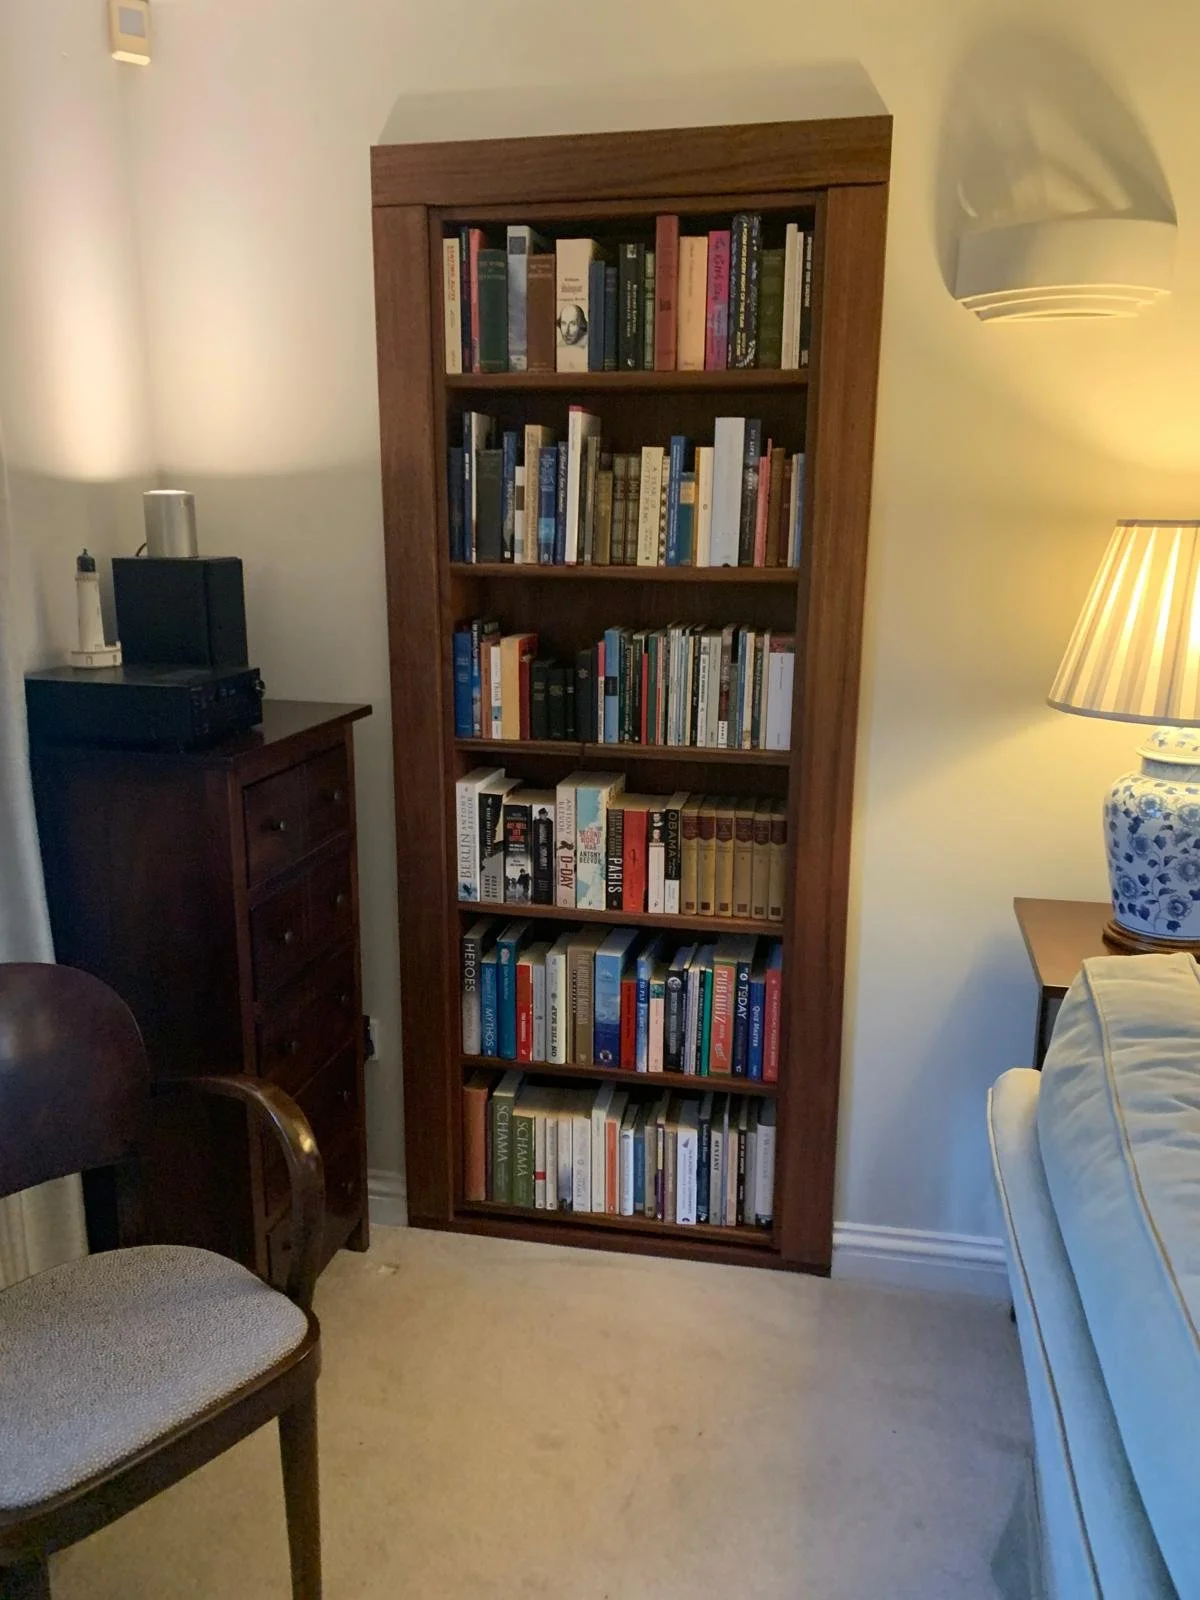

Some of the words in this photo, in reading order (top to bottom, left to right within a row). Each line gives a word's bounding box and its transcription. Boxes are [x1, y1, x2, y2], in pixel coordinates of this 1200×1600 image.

[668, 812, 678, 858] OBAMA
[460, 833, 472, 878] BERLIN
[560, 856, 573, 889] D-DAY
[608, 858, 623, 894] PARIS
[464, 943, 475, 992] HEROES
[713, 970, 728, 993] PUB
[713, 994, 728, 1024] QUIZ
[738, 984, 749, 1020] TODAY
[752, 1005, 760, 1022] QUIZ
[485, 1007, 494, 1047] MYTHOS
[752, 1022, 760, 1047] MASTER
[551, 1045, 558, 1057] ON
[496, 1105, 509, 1162] SCHAMA
[516, 1120, 529, 1176] SCHAMA
